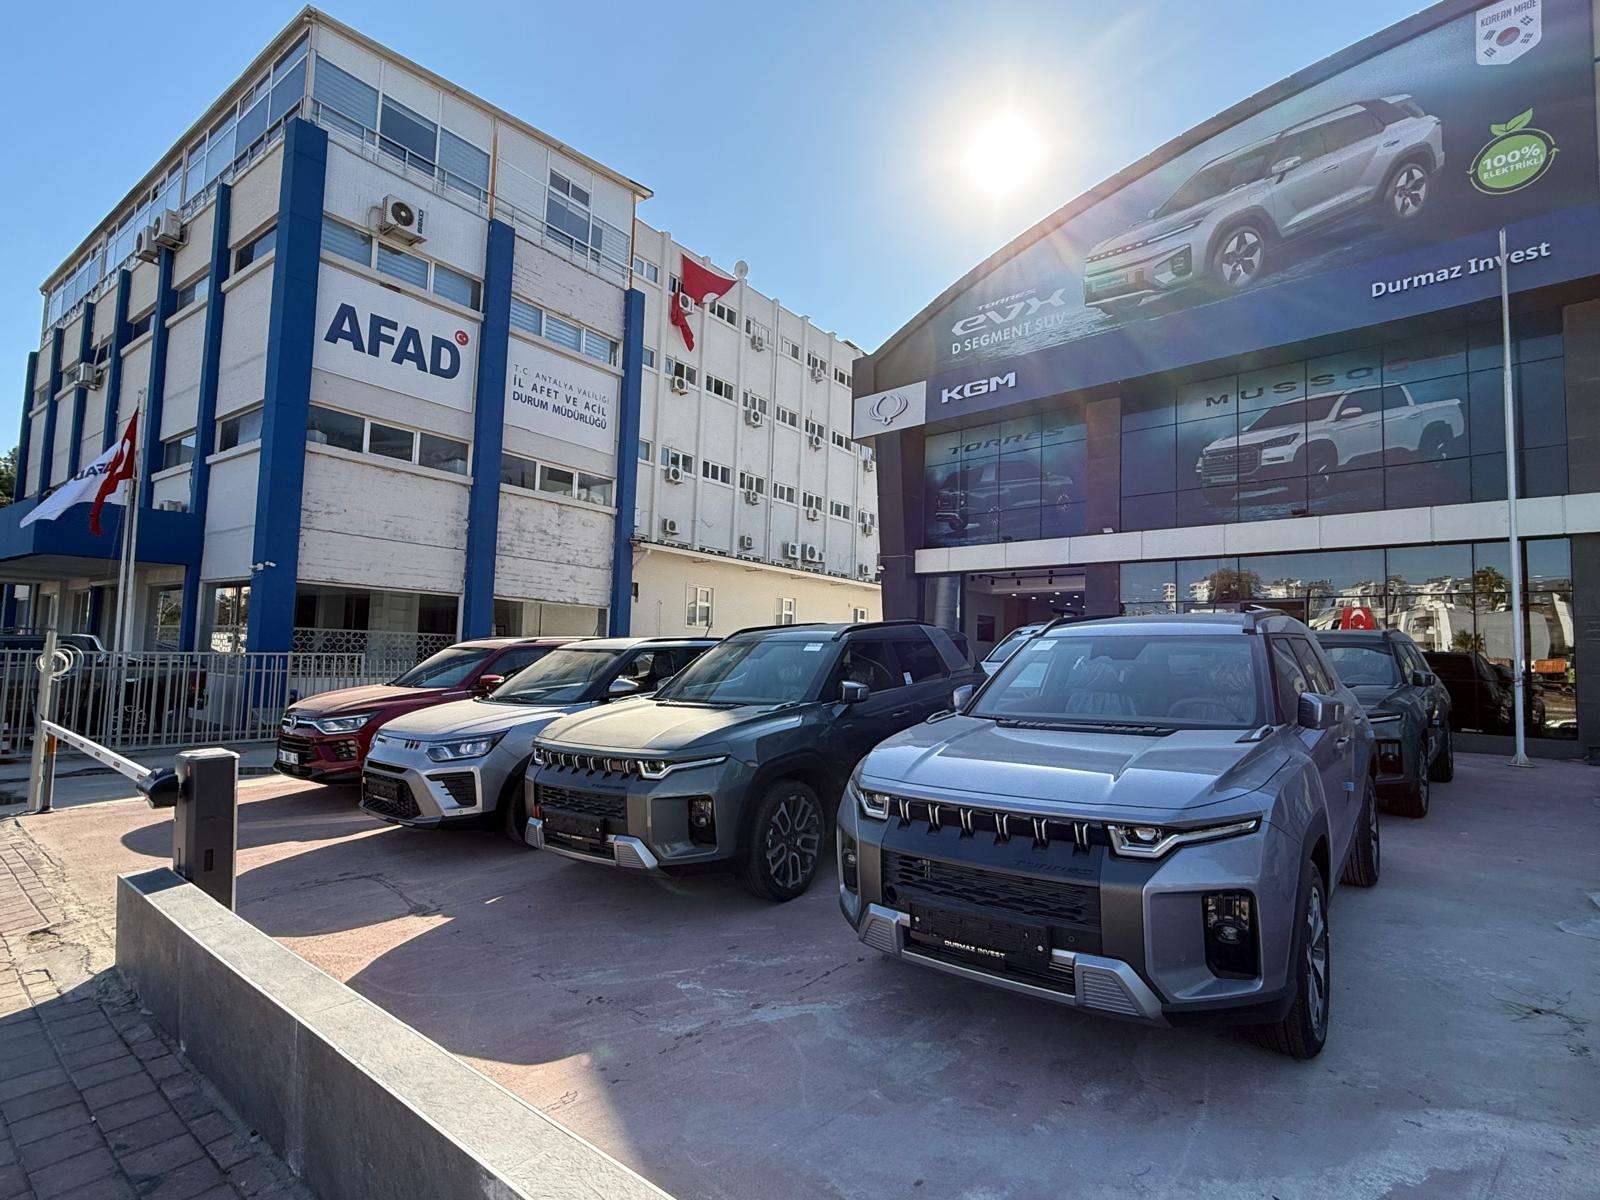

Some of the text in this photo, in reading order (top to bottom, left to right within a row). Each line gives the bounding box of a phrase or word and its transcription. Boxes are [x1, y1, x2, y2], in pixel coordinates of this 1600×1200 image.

[1480, 0, 1537, 28] KOREAN MADE
[1483, 143, 1541, 170] 100%
[1371, 242, 1551, 298] Durmaz Invest
[324, 302, 461, 380] AFAD
[952, 312, 1066, 355] D SEGMENT SUV
[531, 383, 560, 400] AFET
[565, 394, 578, 407] VE
[535, 372, 574, 392] ANTALYA
[941, 371, 1017, 404] KGM
[1206, 365, 1373, 407] MUSSO
[512, 390, 607, 430] DURUM MÜDÜRLÜĞÜ
[949, 429, 1064, 455] TORRES
